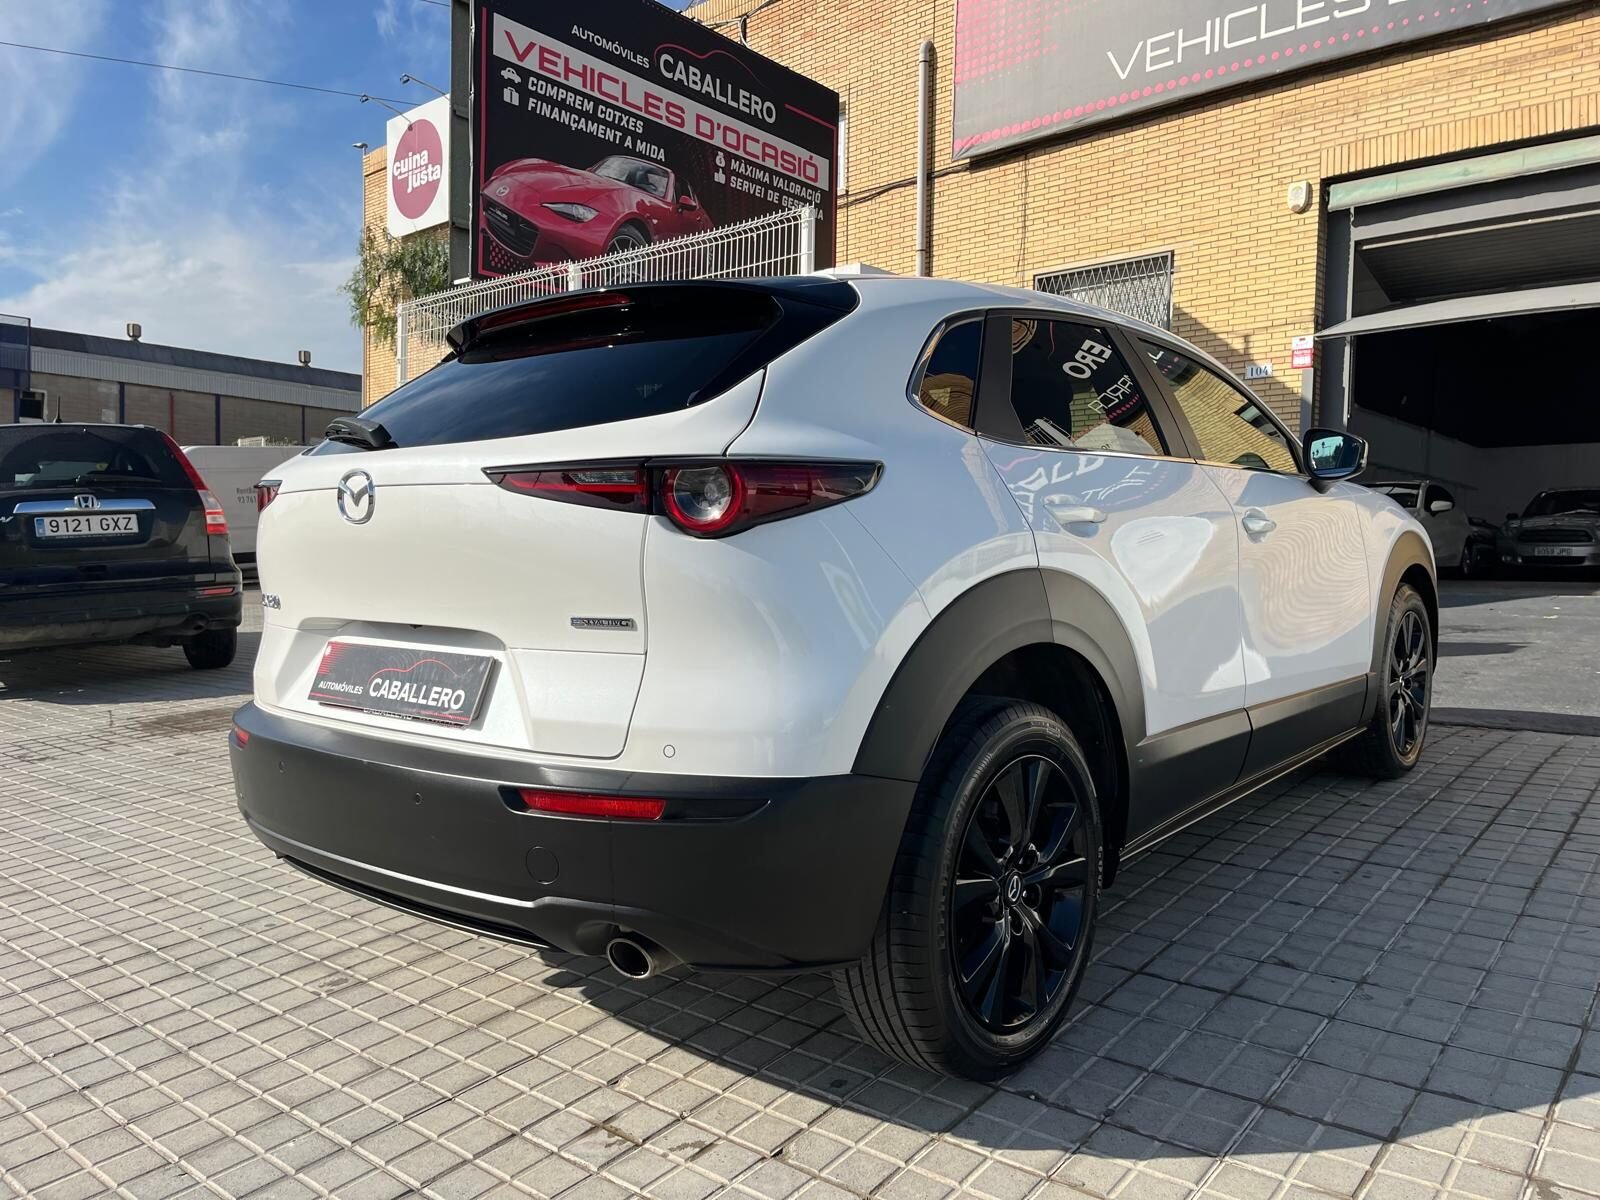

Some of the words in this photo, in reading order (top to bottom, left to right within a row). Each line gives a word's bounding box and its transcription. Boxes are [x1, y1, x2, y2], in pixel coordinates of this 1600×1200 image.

[571, 25, 650, 68] AUTOMÓVILES
[504, 30, 685, 129] VEHICLES
[695, 113, 819, 183] D'OCASIÓ
[527, 76, 594, 114] COMPREM
[597, 105, 644, 133] COTXES
[659, 53, 776, 123] CABALLERO
[527, 98, 622, 144] FINANÇAMENT
[624, 135, 632, 149] A
[636, 139, 665, 161] MIDA
[393, 150, 428, 176] cuina
[407, 164, 440, 193] justa
[730, 159, 769, 184] MÀXIMA
[772, 175, 821, 203] VALORACIÓ
[730, 176, 764, 198] SERVEI
[767, 189, 779, 203] DE
[781, 195, 824, 220] GESTIA
[1250, 366, 1268, 377] 104
[49, 517, 91, 533] 9121
[100, 516, 133, 531] GXZ
[318, 681, 363, 695] AUTOMÓVILES
[369, 677, 465, 710] CABALLERO
